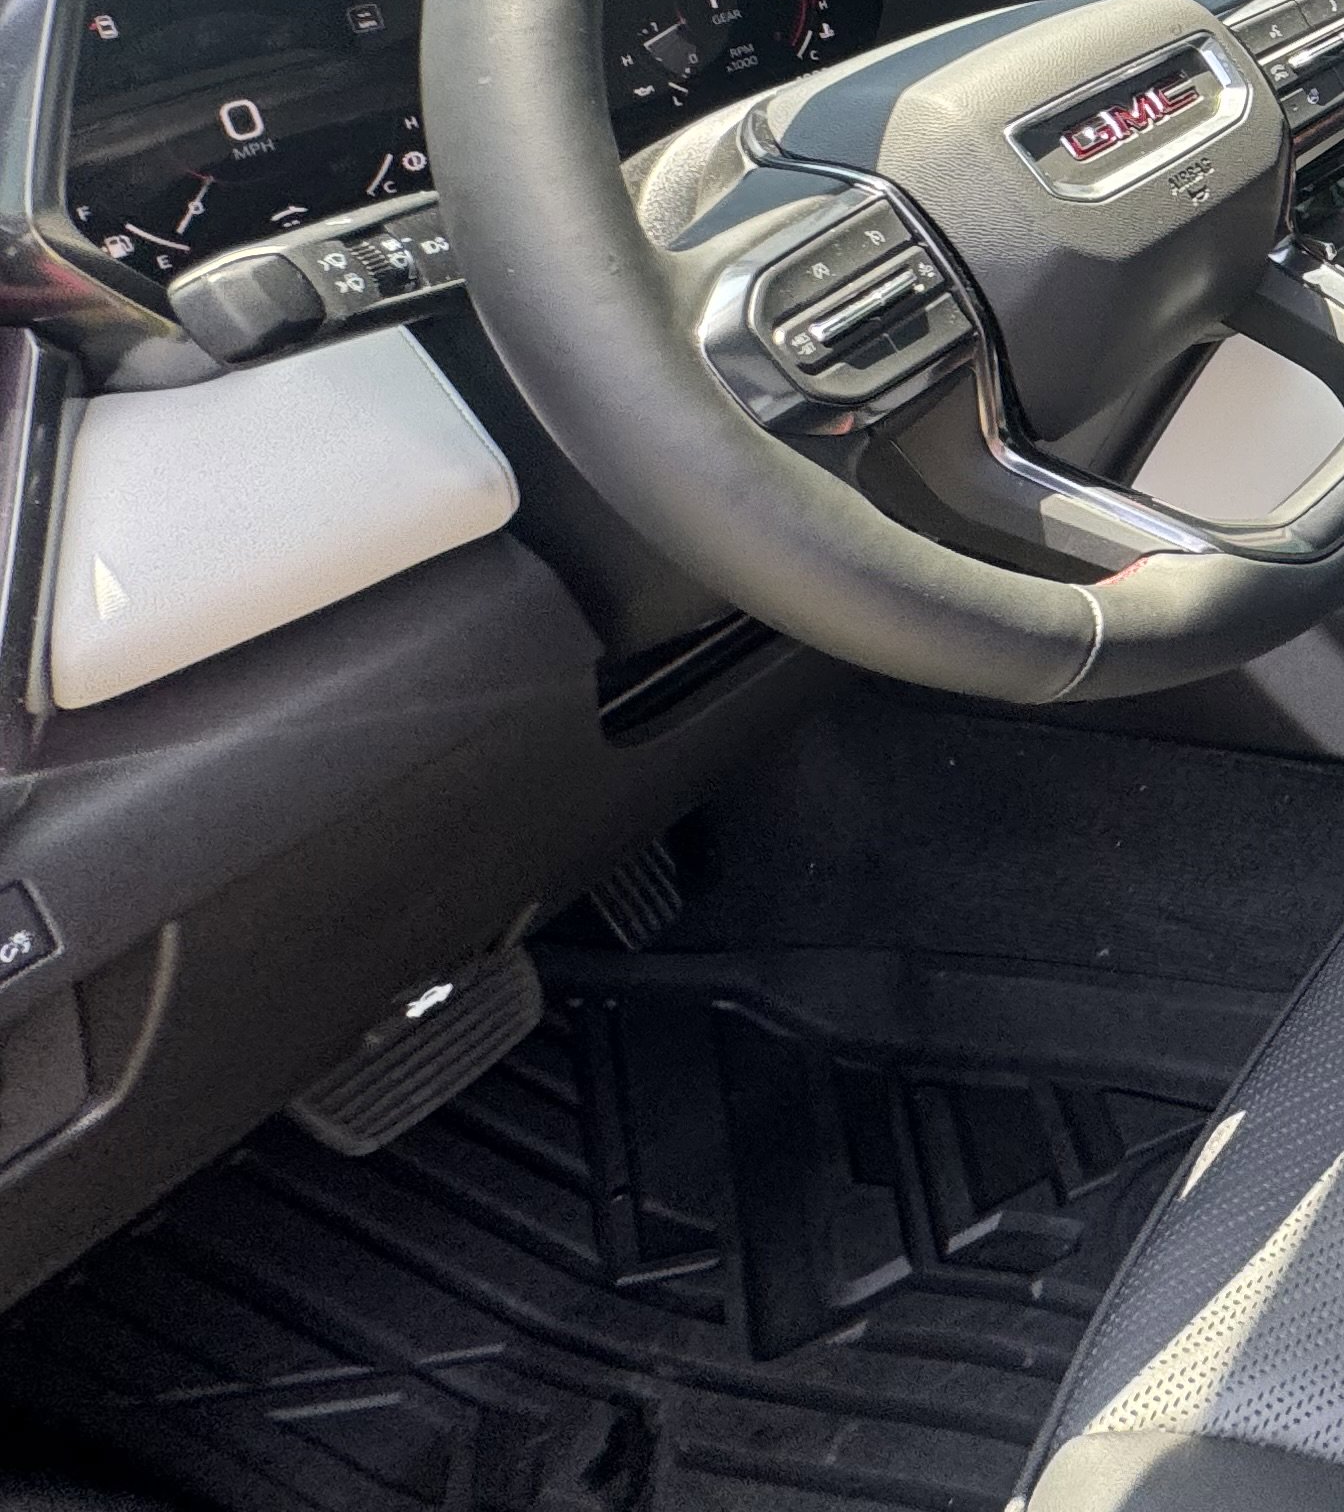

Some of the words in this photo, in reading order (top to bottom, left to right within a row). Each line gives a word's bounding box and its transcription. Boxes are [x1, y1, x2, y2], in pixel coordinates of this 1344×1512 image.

[712, 9, 743, 25] GEAR
[729, 43, 755, 60] RPM
[218, 98, 265, 142] 0
[1059, 74, 1204, 164] GMC
[232, 138, 277, 162] MPH
[156, 254, 173, 270] E
